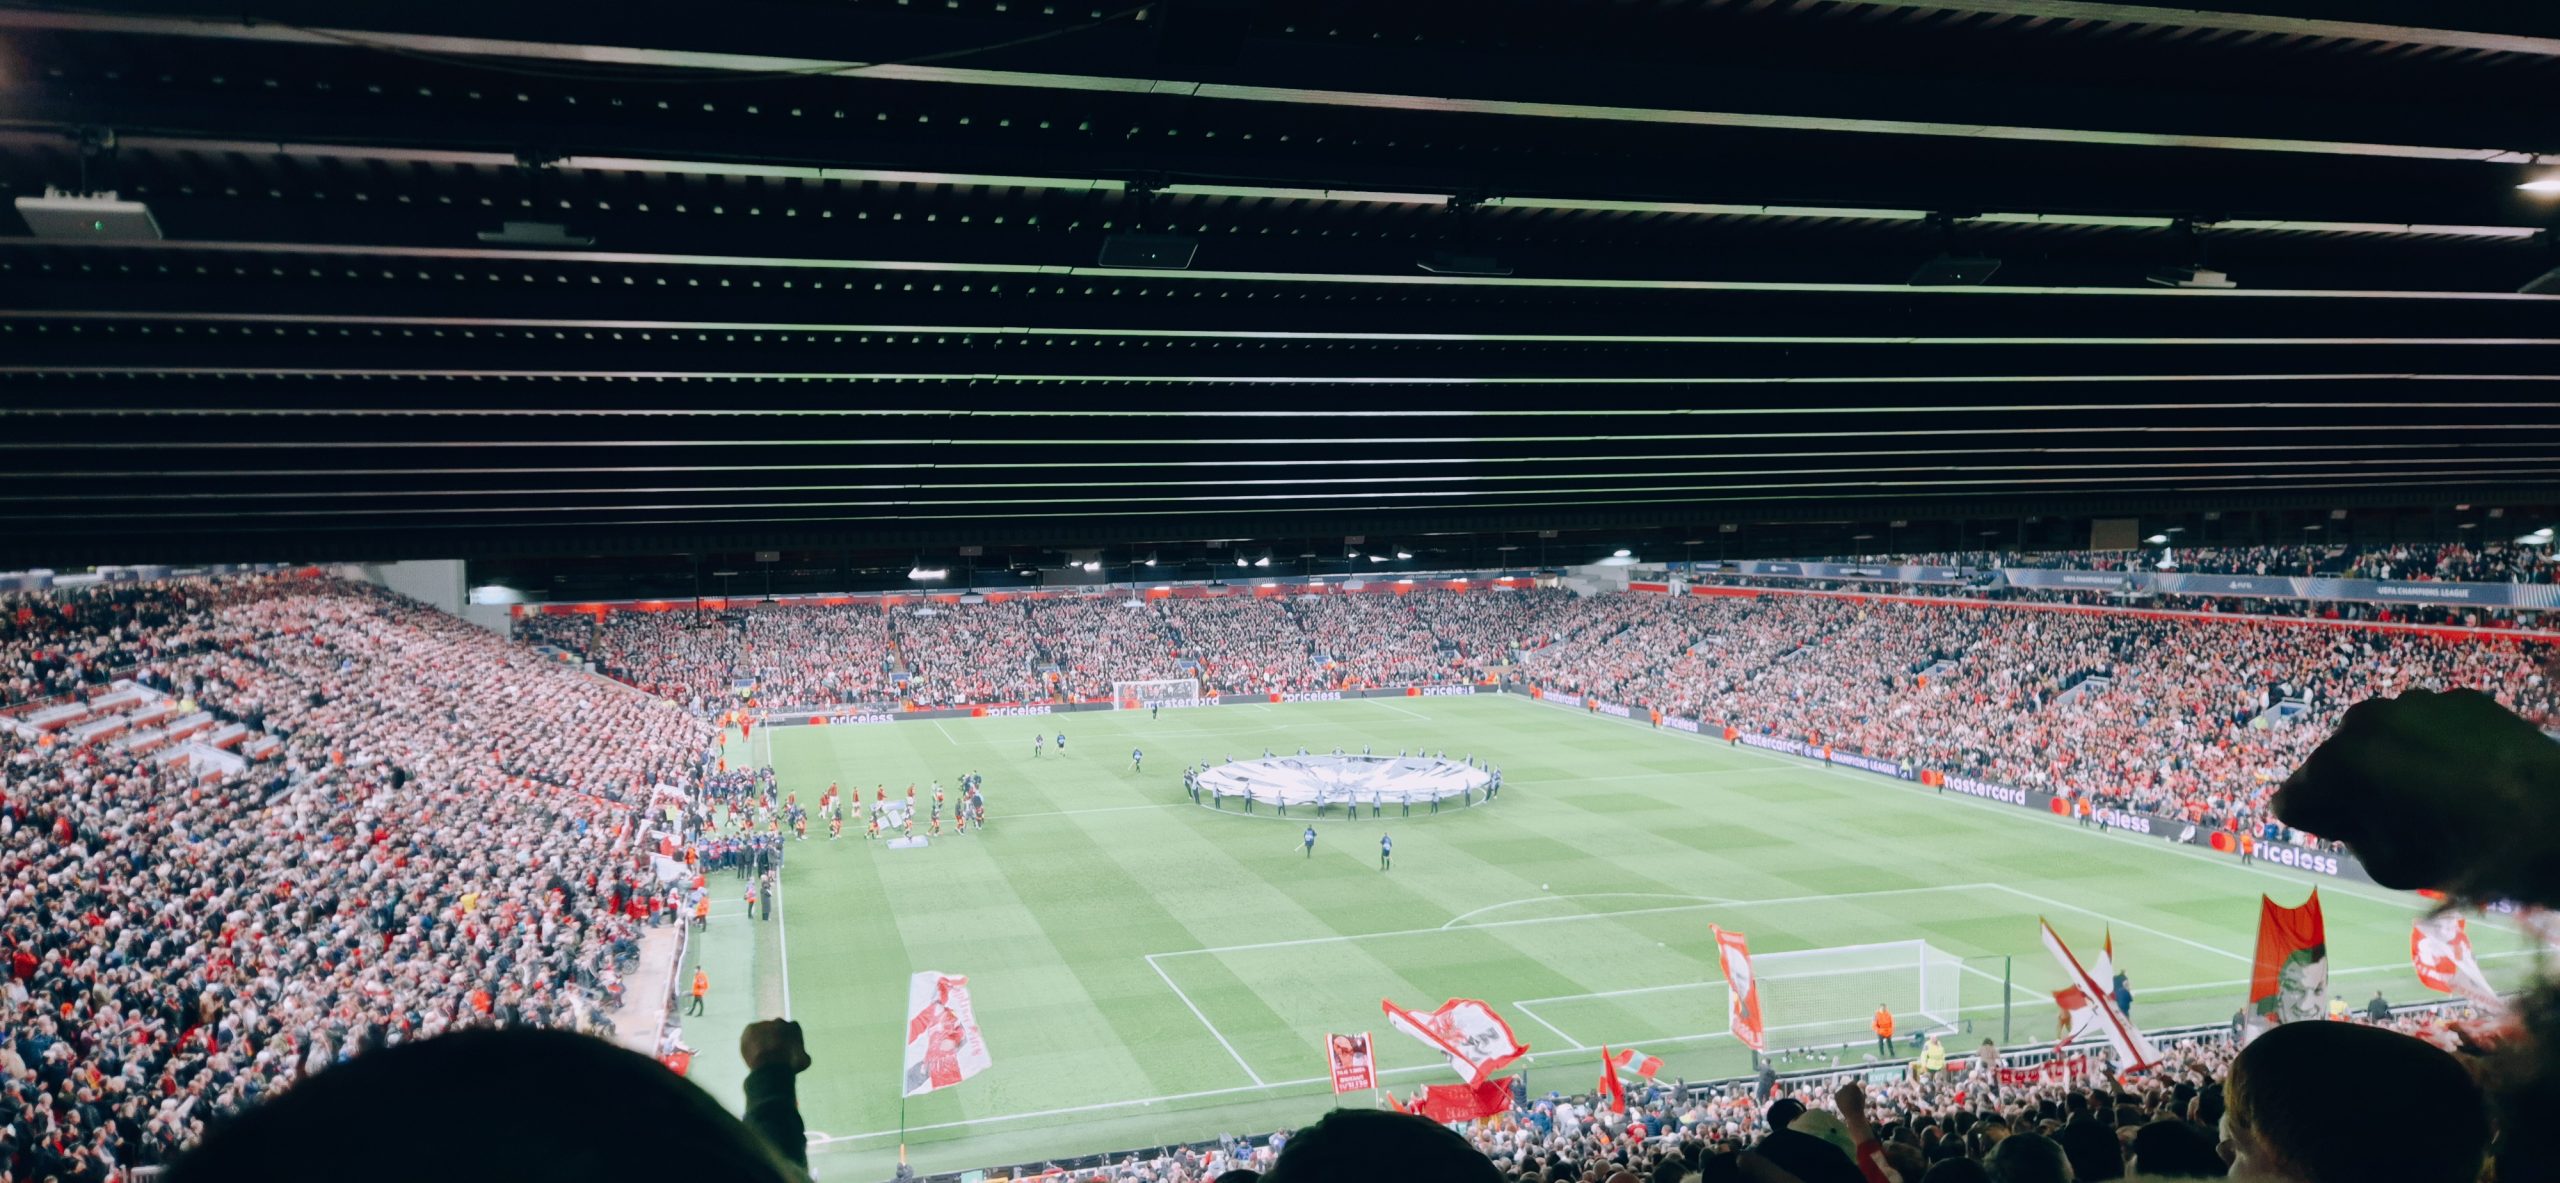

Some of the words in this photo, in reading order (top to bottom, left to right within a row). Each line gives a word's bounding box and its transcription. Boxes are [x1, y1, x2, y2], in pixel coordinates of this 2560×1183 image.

[2378, 586, 2397, 595] UEFA
[2397, 587, 2439, 597] CHAMPIONS
[2440, 588, 2470, 598] LEAGUE
[1287, 691, 1340, 702] priceless
[991, 704, 1051, 717] priceless
[830, 712, 894, 725] priceless
[1662, 715, 1698, 732] priceless
[1830, 751, 1869, 769] CHAMPIONS
[1870, 760, 1897, 776] LEAGUE
[2074, 803, 2150, 833] piceless
